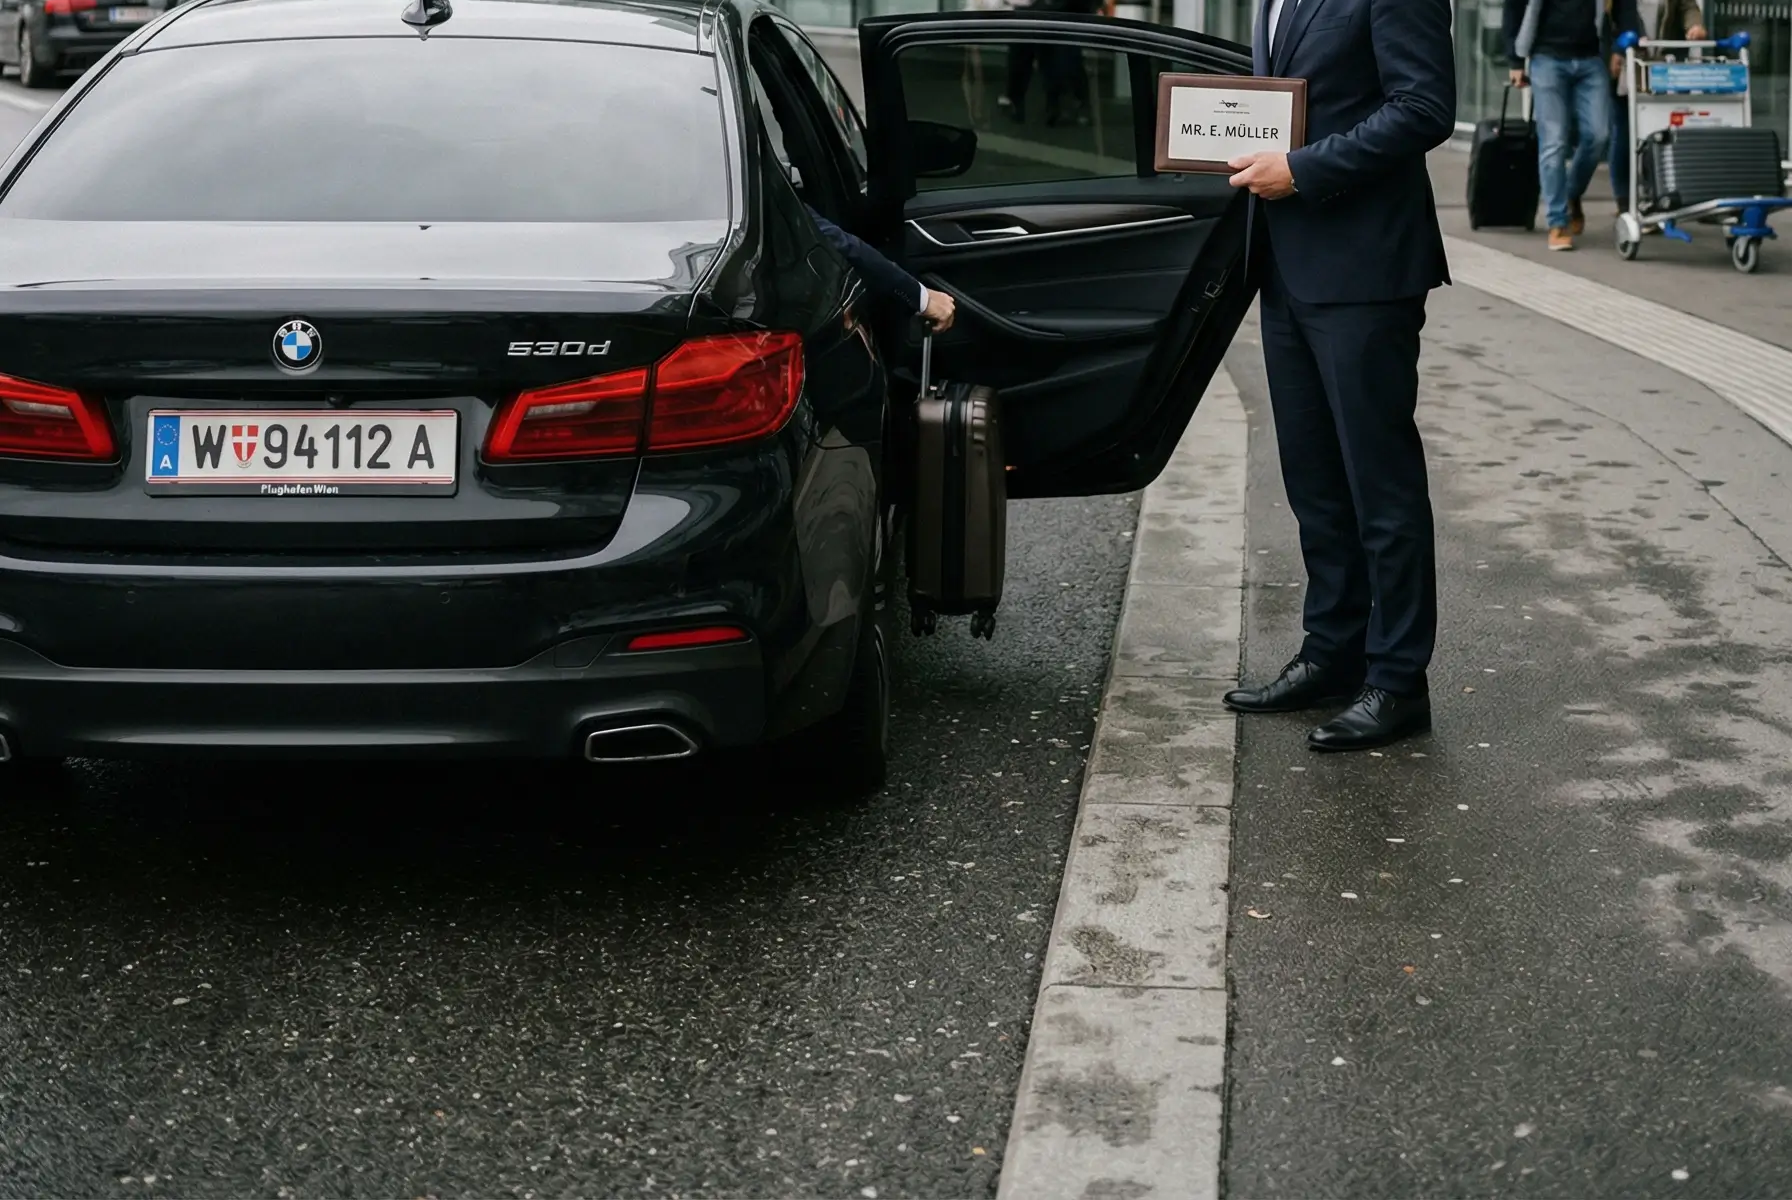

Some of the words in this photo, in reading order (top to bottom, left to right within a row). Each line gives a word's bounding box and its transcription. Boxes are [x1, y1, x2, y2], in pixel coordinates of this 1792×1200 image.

[1181, 123, 1206, 136] MR.
[1210, 125, 1221, 137] E.
[1225, 123, 1279, 139] MÜLLER
[507, 340, 612, 356] 530d
[192, 424, 227, 469] W
[263, 424, 392, 469] 94112
[407, 424, 435, 469] A
[160, 454, 173, 469] A
